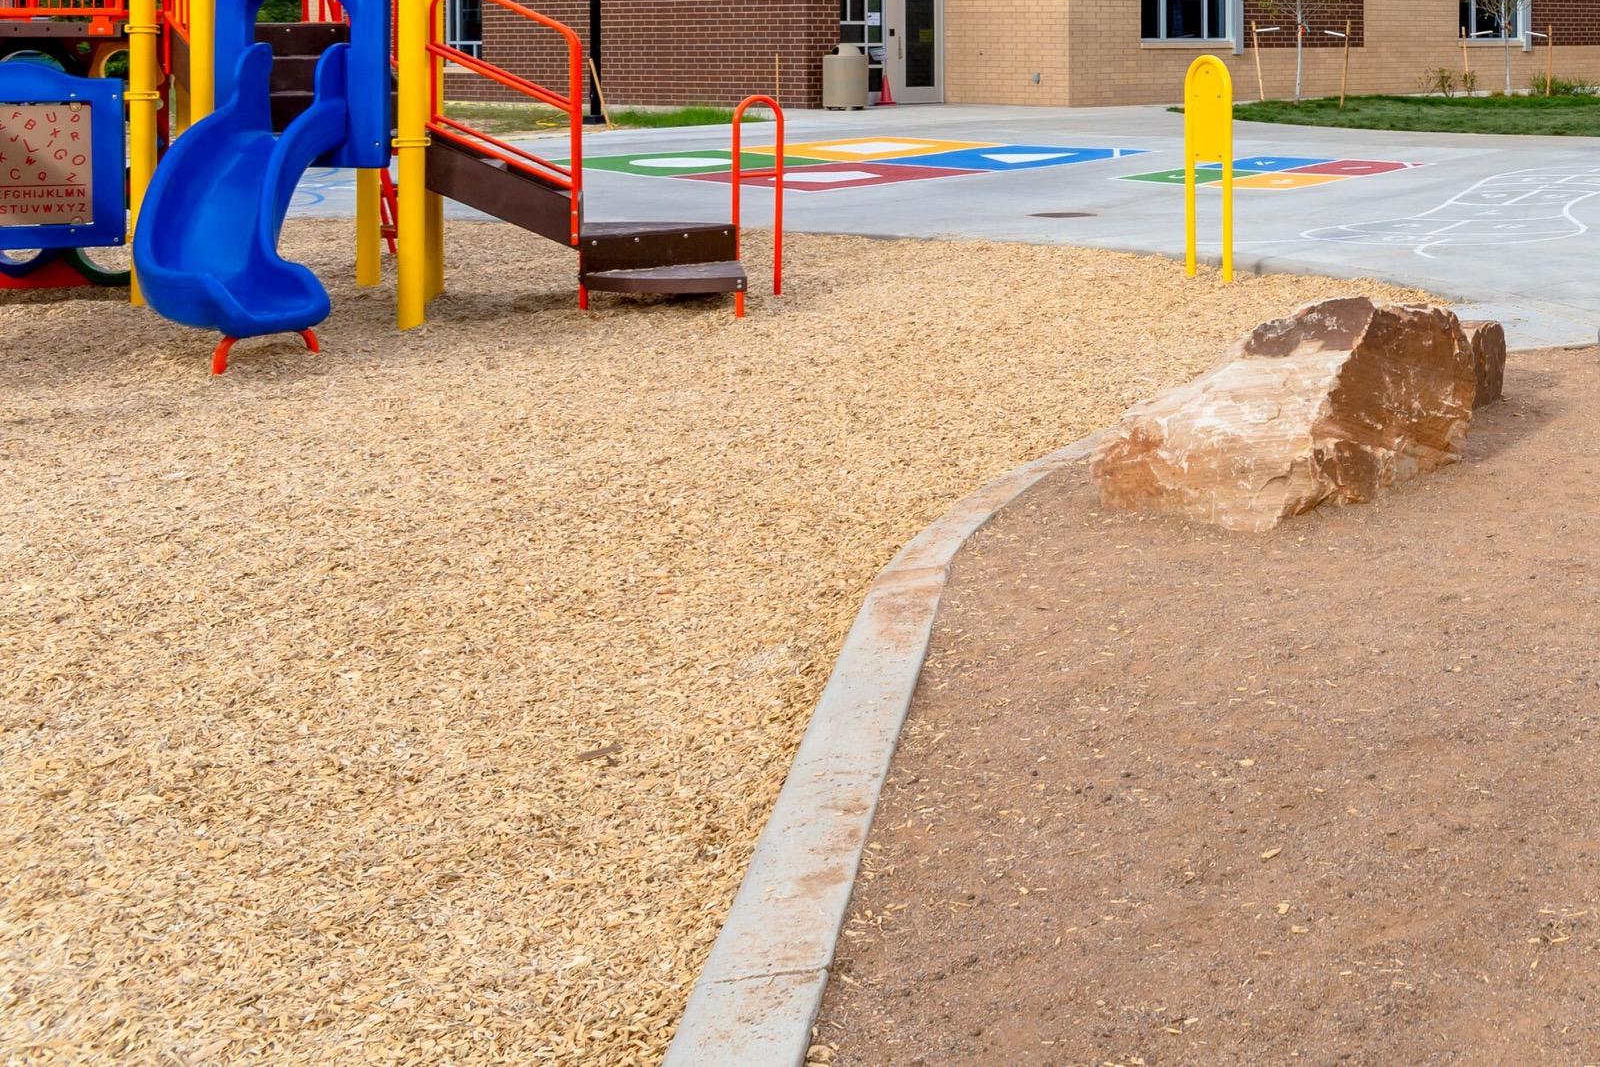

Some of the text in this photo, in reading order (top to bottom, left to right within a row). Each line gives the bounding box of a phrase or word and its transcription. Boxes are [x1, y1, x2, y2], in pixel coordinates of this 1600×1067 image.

[12, 112, 22, 120] F
[46, 112, 57, 123] U
[71, 114, 81, 123] D
[24, 119, 37, 130] B
[10, 134, 20, 142] J
[71, 132, 80, 141] R
[23, 139, 39, 153] L
[54, 149, 68, 160] G
[72, 154, 86, 166] O
[10, 168, 21, 180] C
[38, 171, 47, 182] Q
[66, 172, 77, 182] Z
